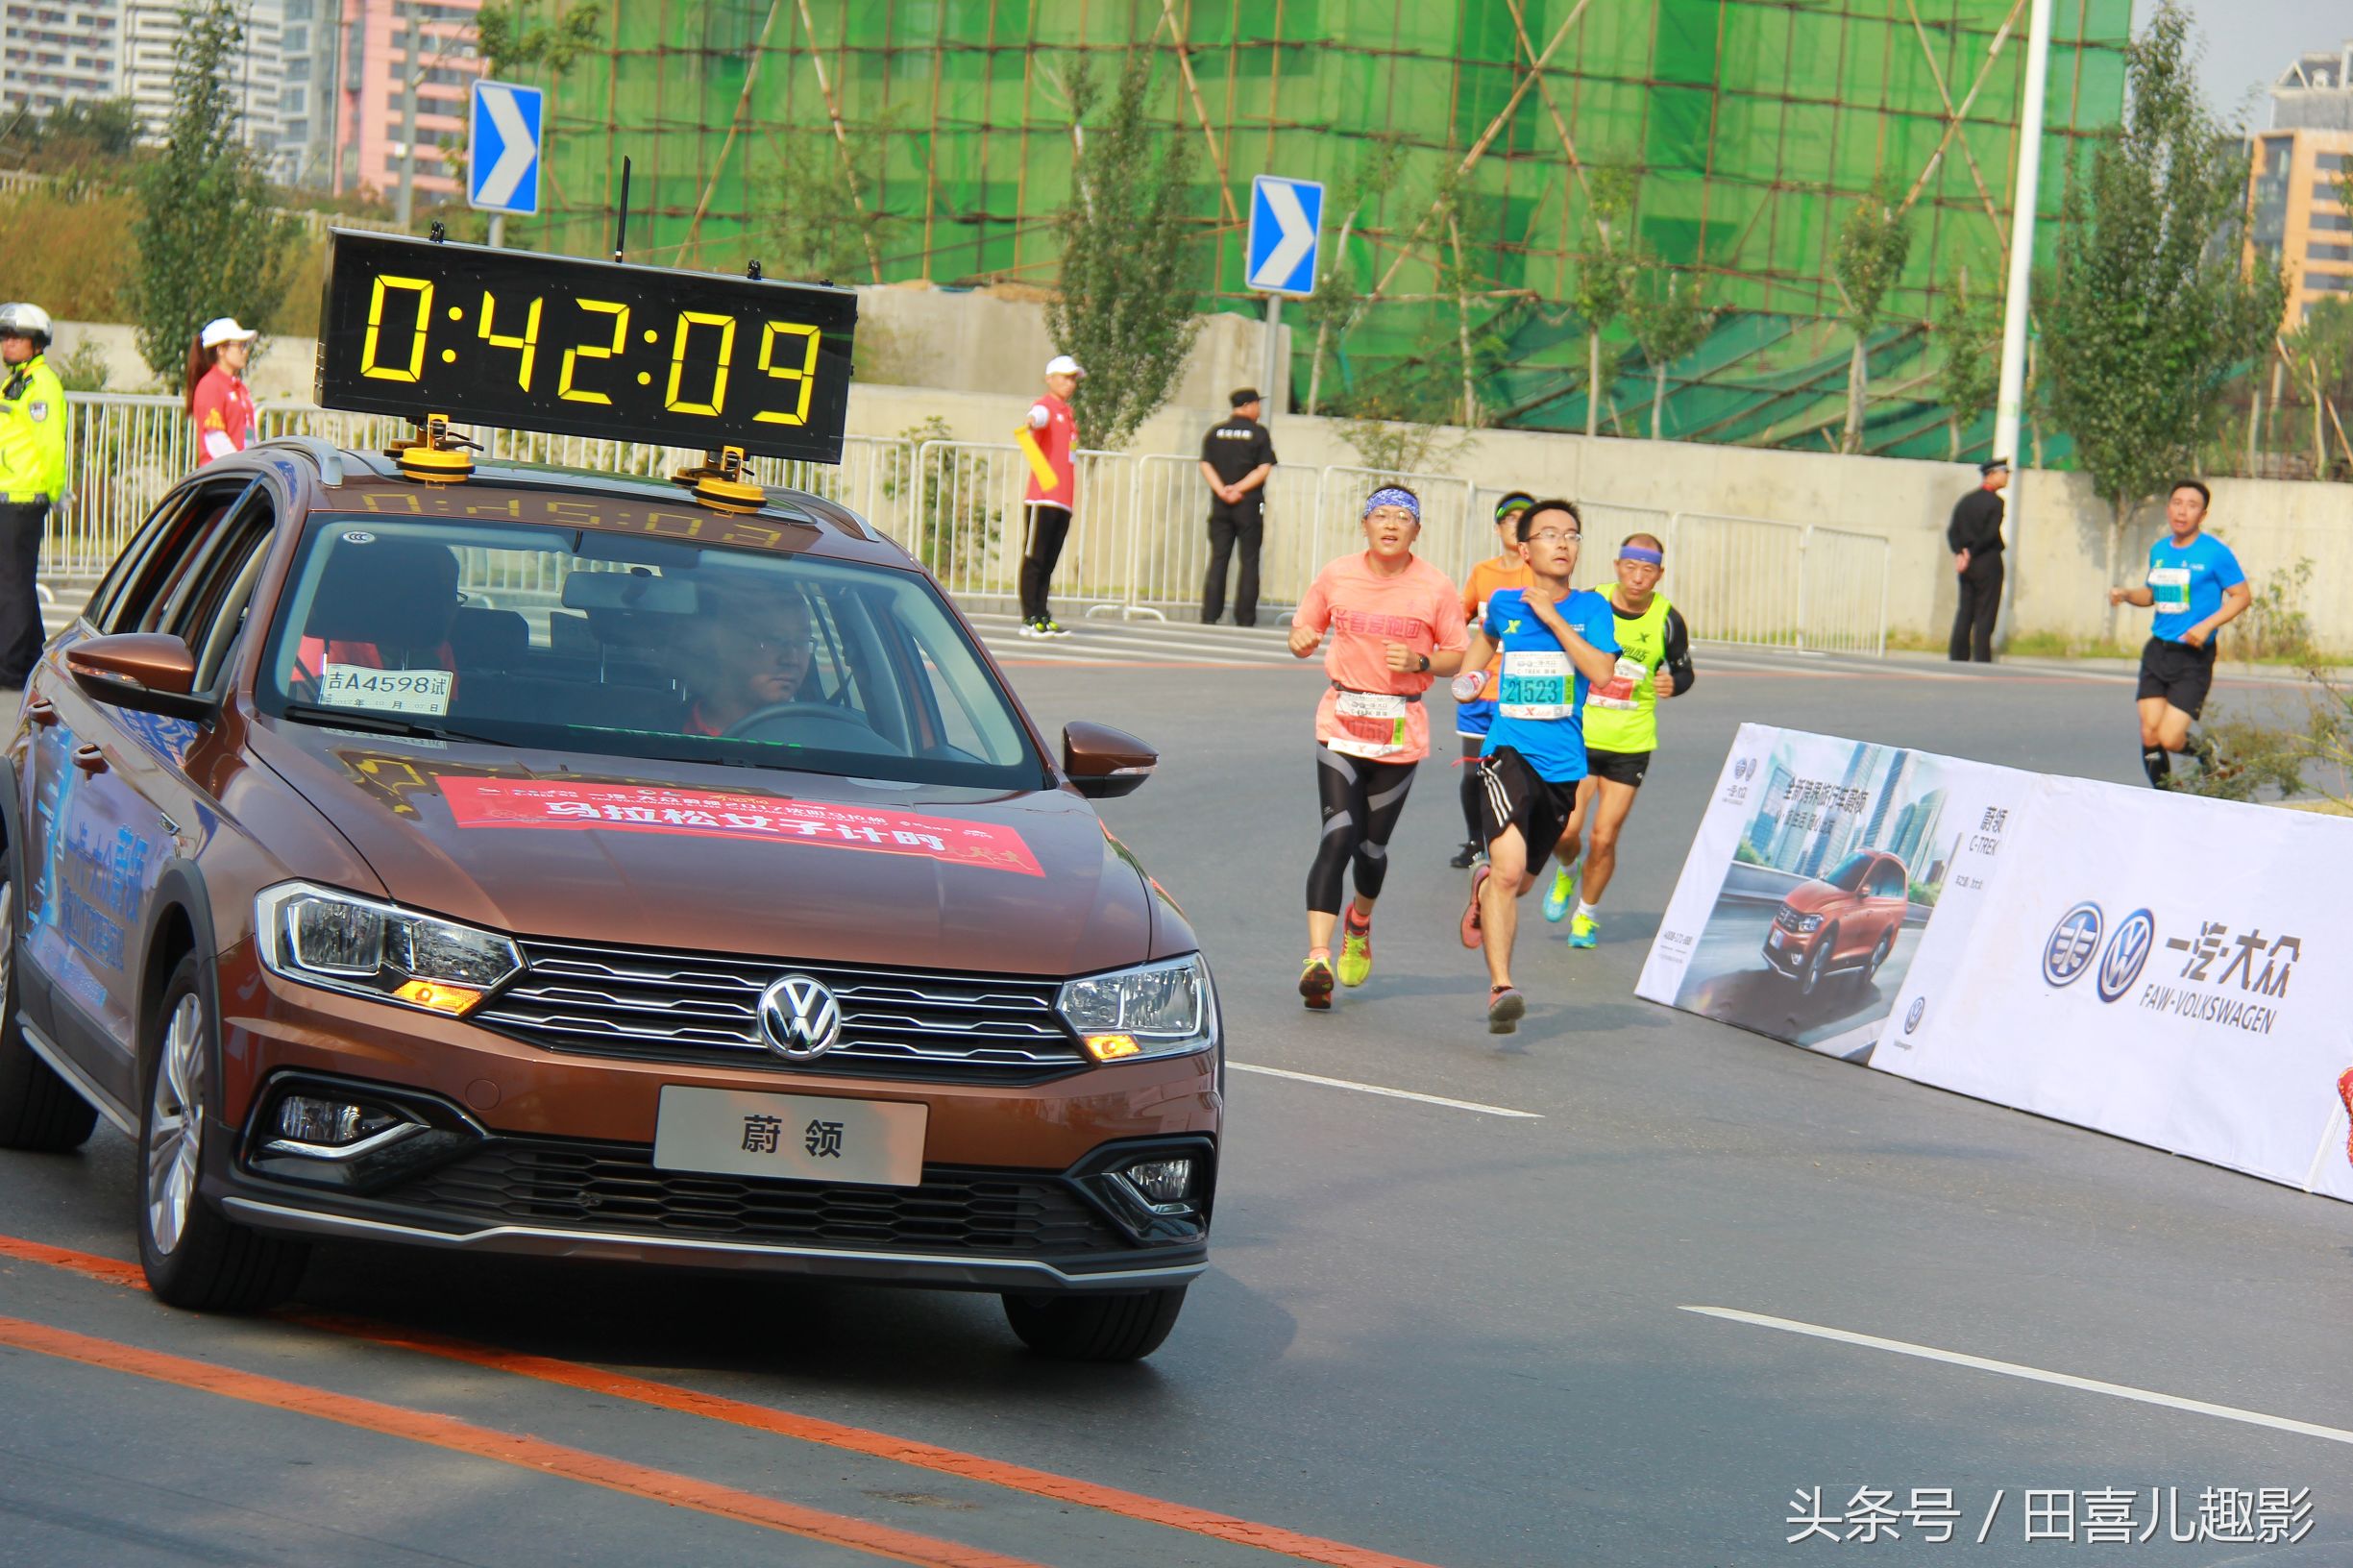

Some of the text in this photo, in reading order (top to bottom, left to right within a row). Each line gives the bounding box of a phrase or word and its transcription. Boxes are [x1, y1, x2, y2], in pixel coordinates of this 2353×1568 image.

[360, 275, 821, 426] 0:42:09
[328, 672, 447, 696] 吉A4598试
[1506, 679, 1557, 703] 21523
[546, 801, 945, 850] 马拉松女子计时
[1969, 834, 1999, 856] C-TREK
[2139, 983, 2277, 1035] FAW-VOLKSWAGEN
[741, 1115, 845, 1159] 蔚领
